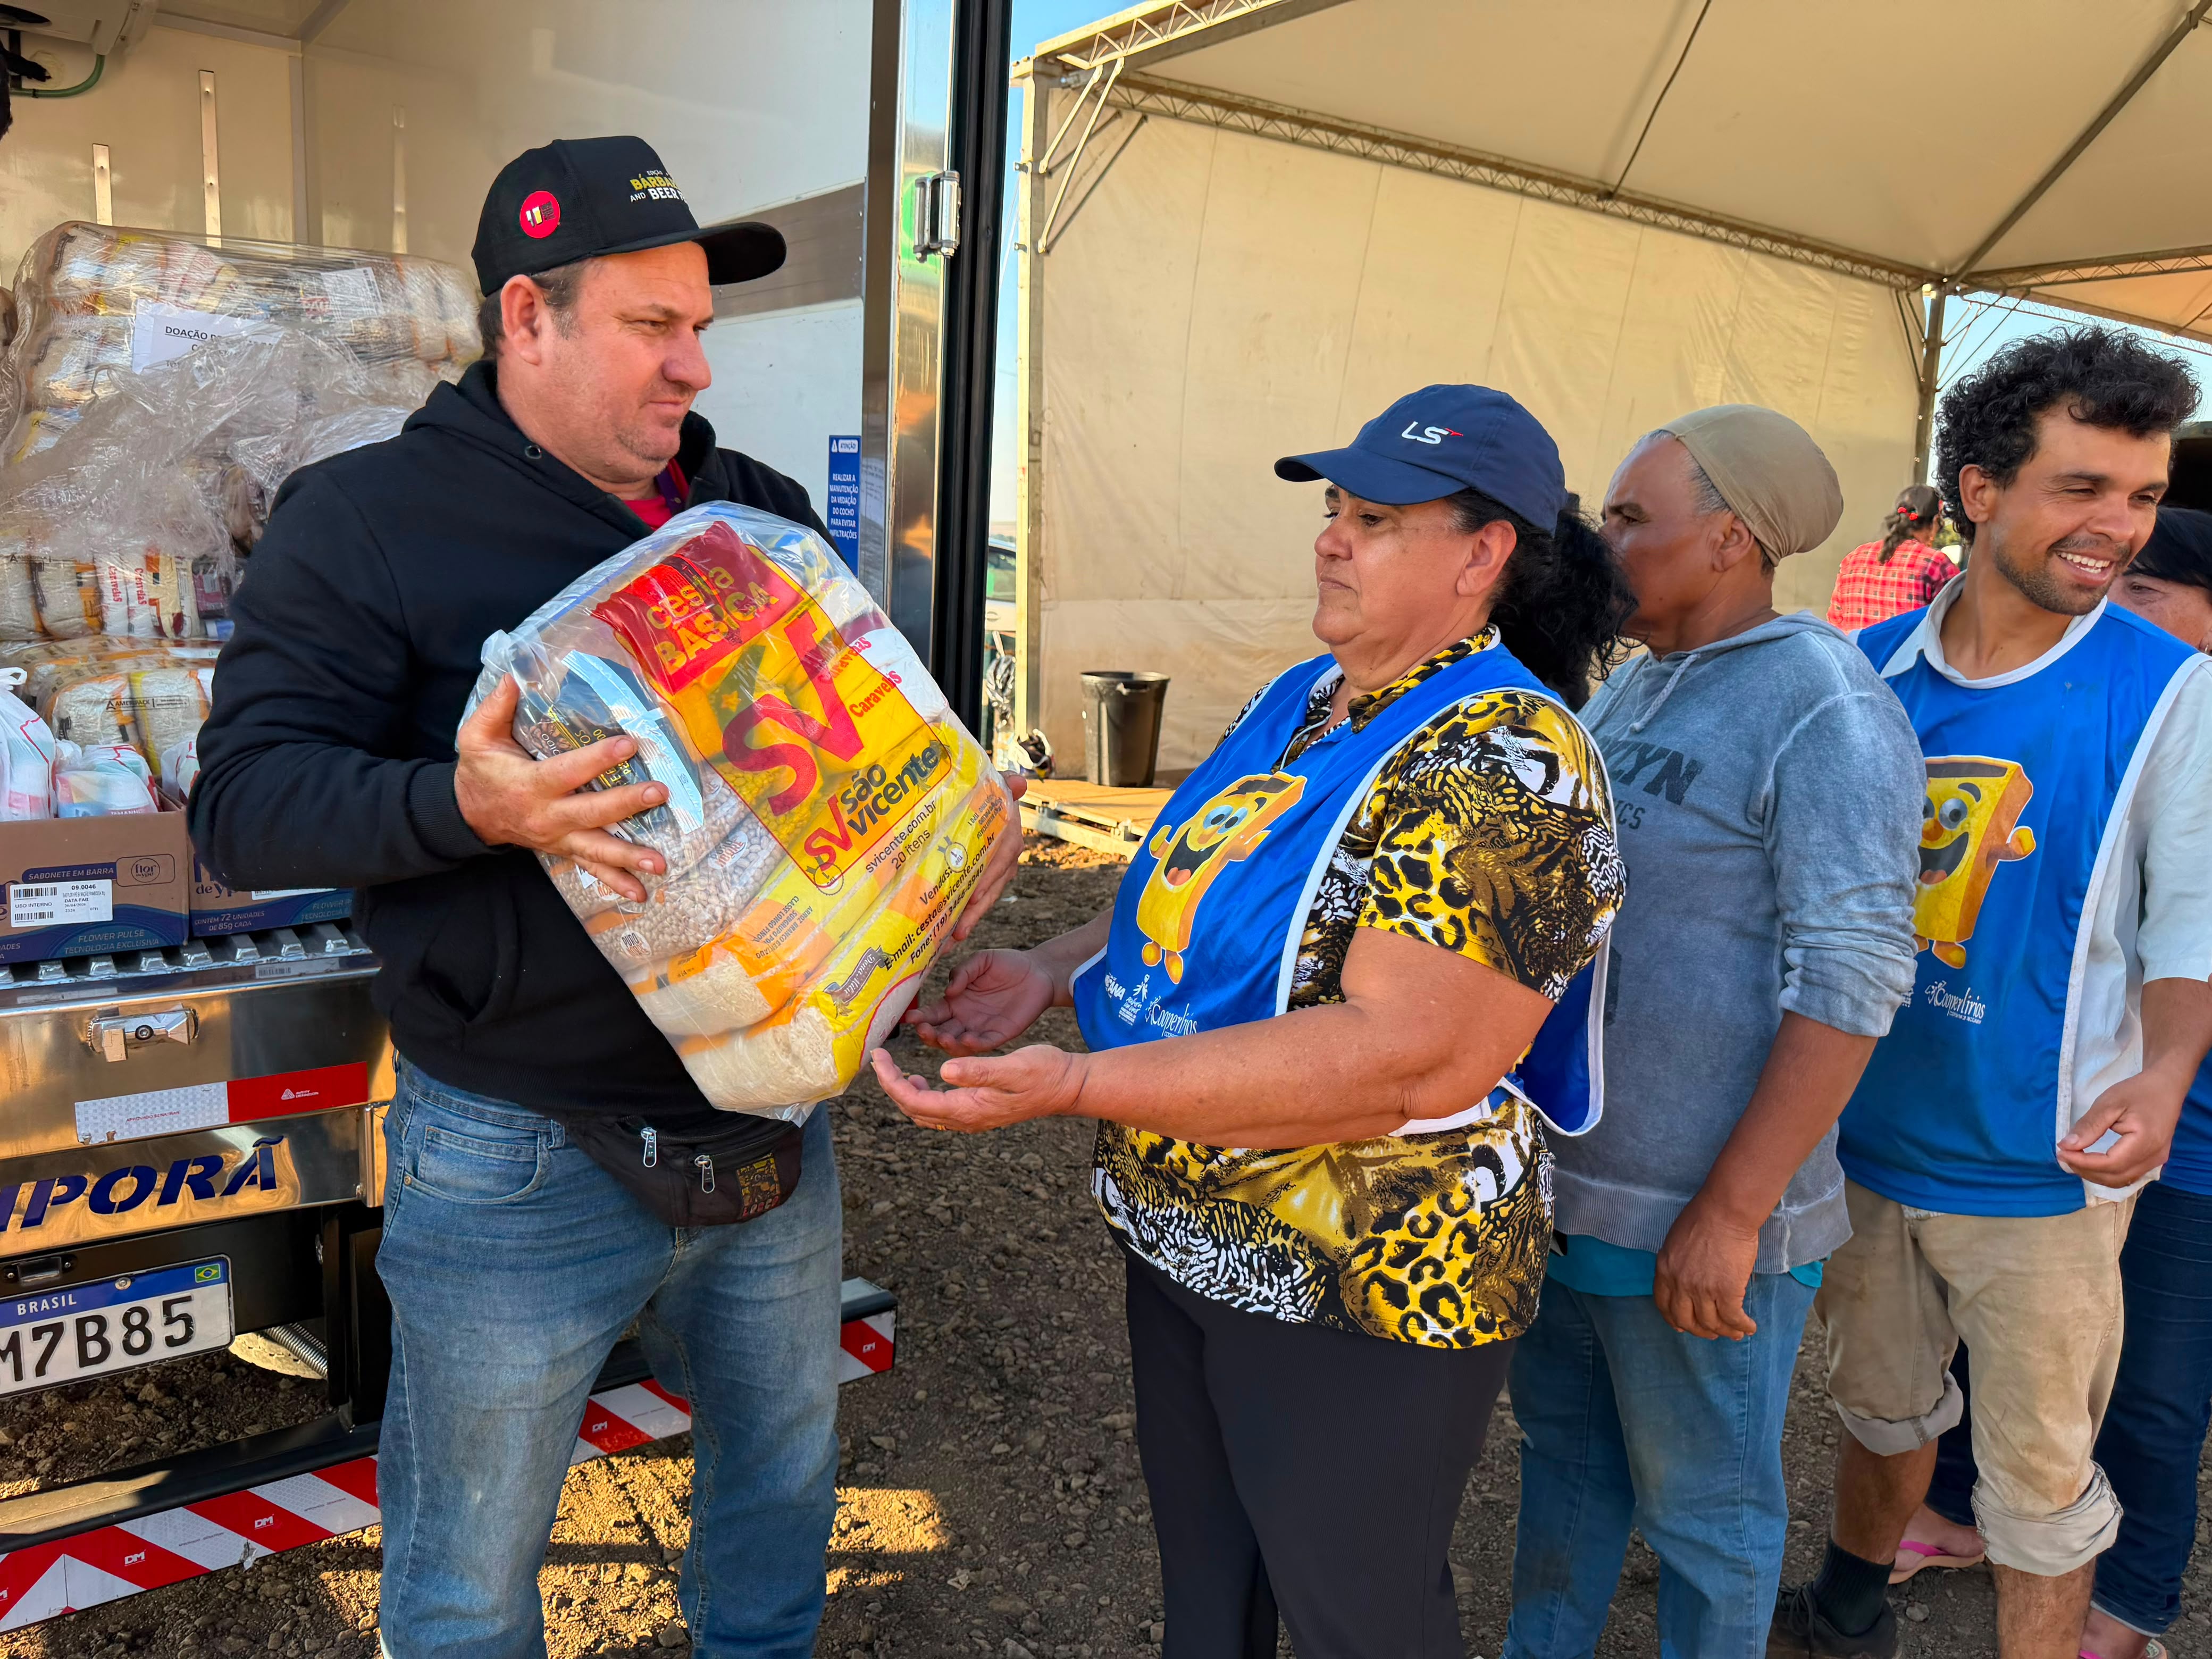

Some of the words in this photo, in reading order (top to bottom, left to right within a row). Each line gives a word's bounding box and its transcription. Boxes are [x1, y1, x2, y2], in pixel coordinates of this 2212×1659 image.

[630, 192, 646, 202] AND
[648, 187, 679, 199] BEER
[165, 326, 208, 340] DOAÇÃO
[1402, 421, 1449, 444] LS
[830, 484, 859, 495] MANUTENÇÃO
[837, 495, 857, 506] VEDAÇÃO
[839, 507, 854, 516] COCHO
[831, 518, 841, 526] PARA
[842, 519, 856, 527] EVITAR
[647, 567, 735, 630] cesta
[654, 581, 780, 675] BÁSICA
[722, 610, 864, 817] SV
[840, 764, 886, 815] são
[847, 746, 939, 836] vicente
[803, 794, 853, 872] SV
[865, 799, 937, 873] svicente.com.br
[891, 851, 906, 870] 20
[906, 830, 931, 854] itens
[28, 870, 71, 880] SABONETE
[86, 867, 114, 876] BARRA
[919, 867, 952, 906] Vendas:
[782, 895, 800, 914] CLASSE
[884, 933, 916, 971] E-mail:
[915, 832, 995, 936] cesta@svicente.com.br
[221, 913, 231, 921] 72
[233, 911, 265, 920] UNIDADES
[767, 911, 785, 929] LONGO
[772, 910, 798, 937] SUBGRUPO
[797, 906, 814, 924] ARROZ
[78, 933, 115, 943] FLOWER
[118, 929, 145, 939] PULSE
[622, 933, 639, 947] PURO
[778, 921, 799, 943] BRANCO
[910, 933, 933, 964] Fone:
[933, 915, 948, 937] (19)
[64, 942, 114, 954] TECNOLOGIA
[116, 939, 160, 949] EXCLUSIVA
[1936, 987, 1986, 1019] Cooperlírios
[17, 1294, 77, 1316] BRASIL
[592, 1421, 608, 1432] DM
[255, 1516, 273, 1528] DM
[124, 1553, 145, 1564] DM
